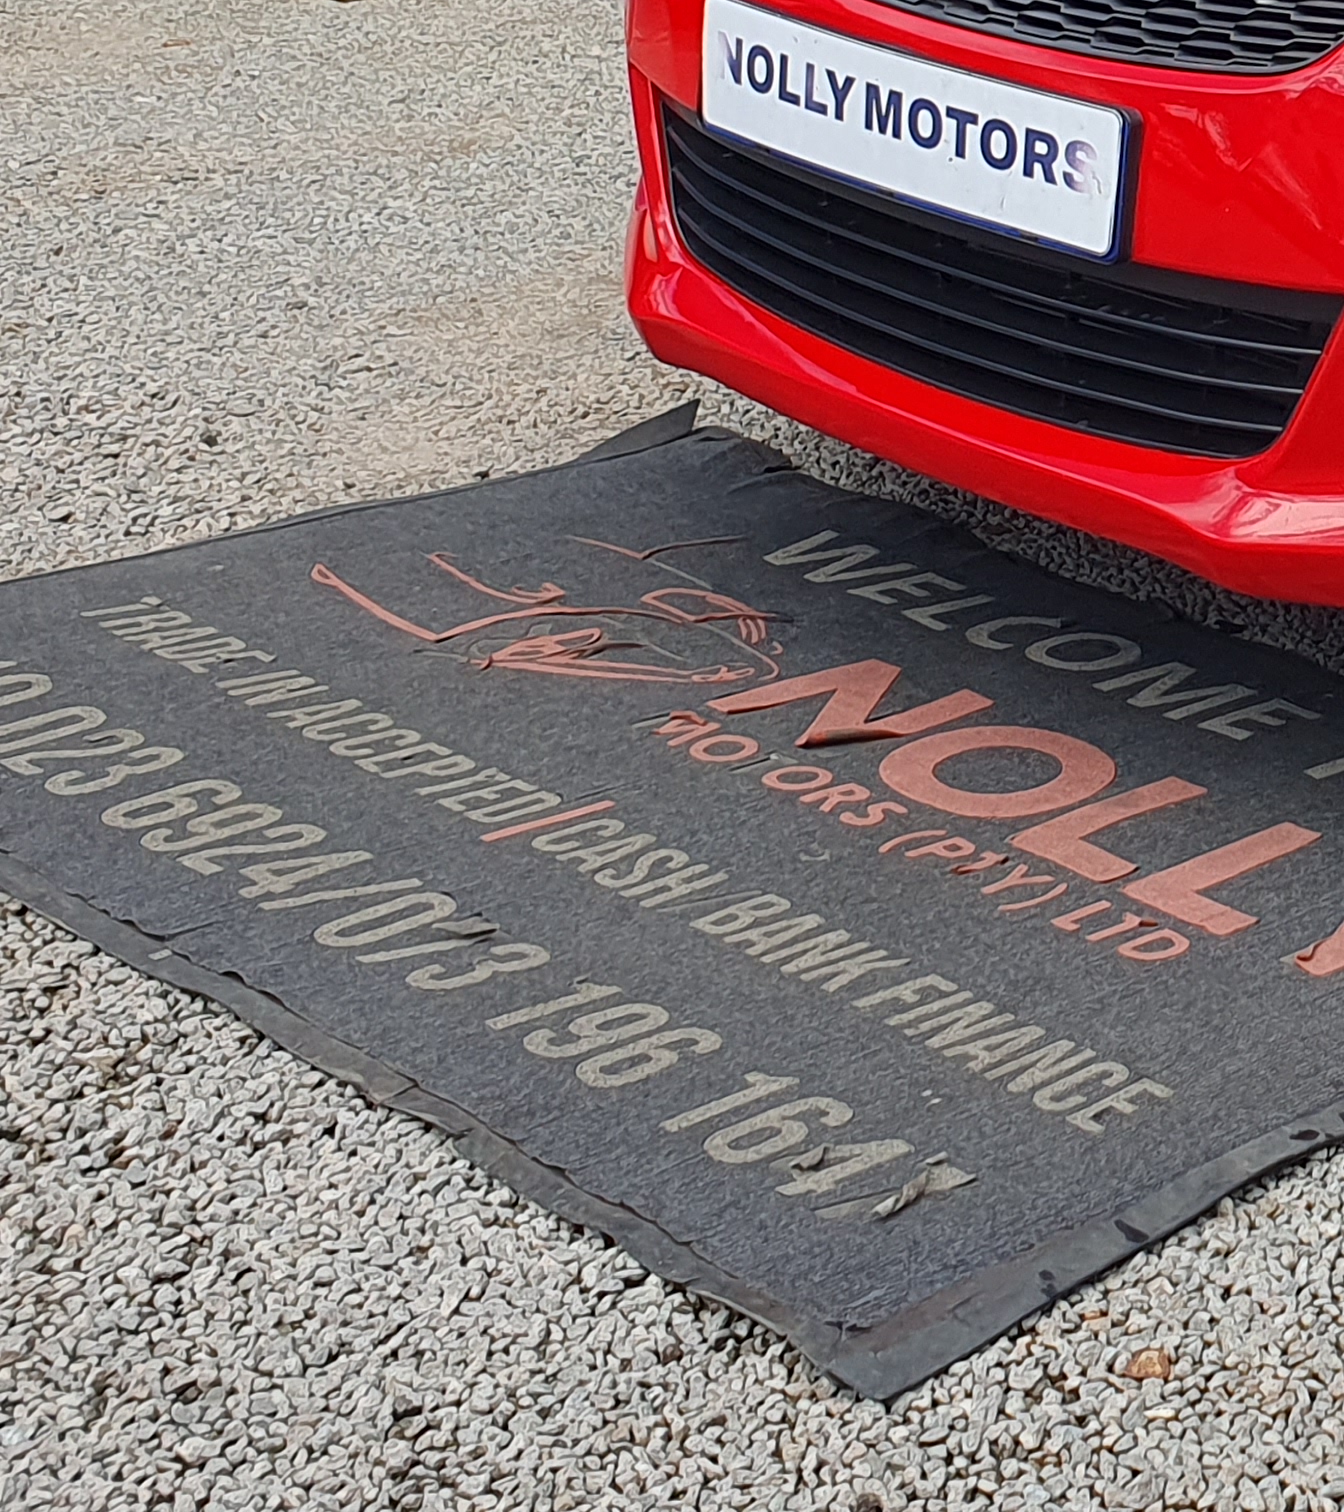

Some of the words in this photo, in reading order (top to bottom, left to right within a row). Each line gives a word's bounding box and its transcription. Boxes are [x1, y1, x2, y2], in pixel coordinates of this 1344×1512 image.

[718, 31, 857, 122] NOLLY
[864, 81, 1101, 194] MOTORS
[80, 596, 276, 673] TRADE
[215, 669, 329, 706] IN
[763, 529, 1323, 741] WELCOME
[266, 699, 562, 823] ACCEPTED
[879, 829, 1068, 910] (PTY)
[1050, 900, 1190, 961] LTD
[484, 976, 722, 1088] 196
[852, 973, 1173, 1133] FINANCE
